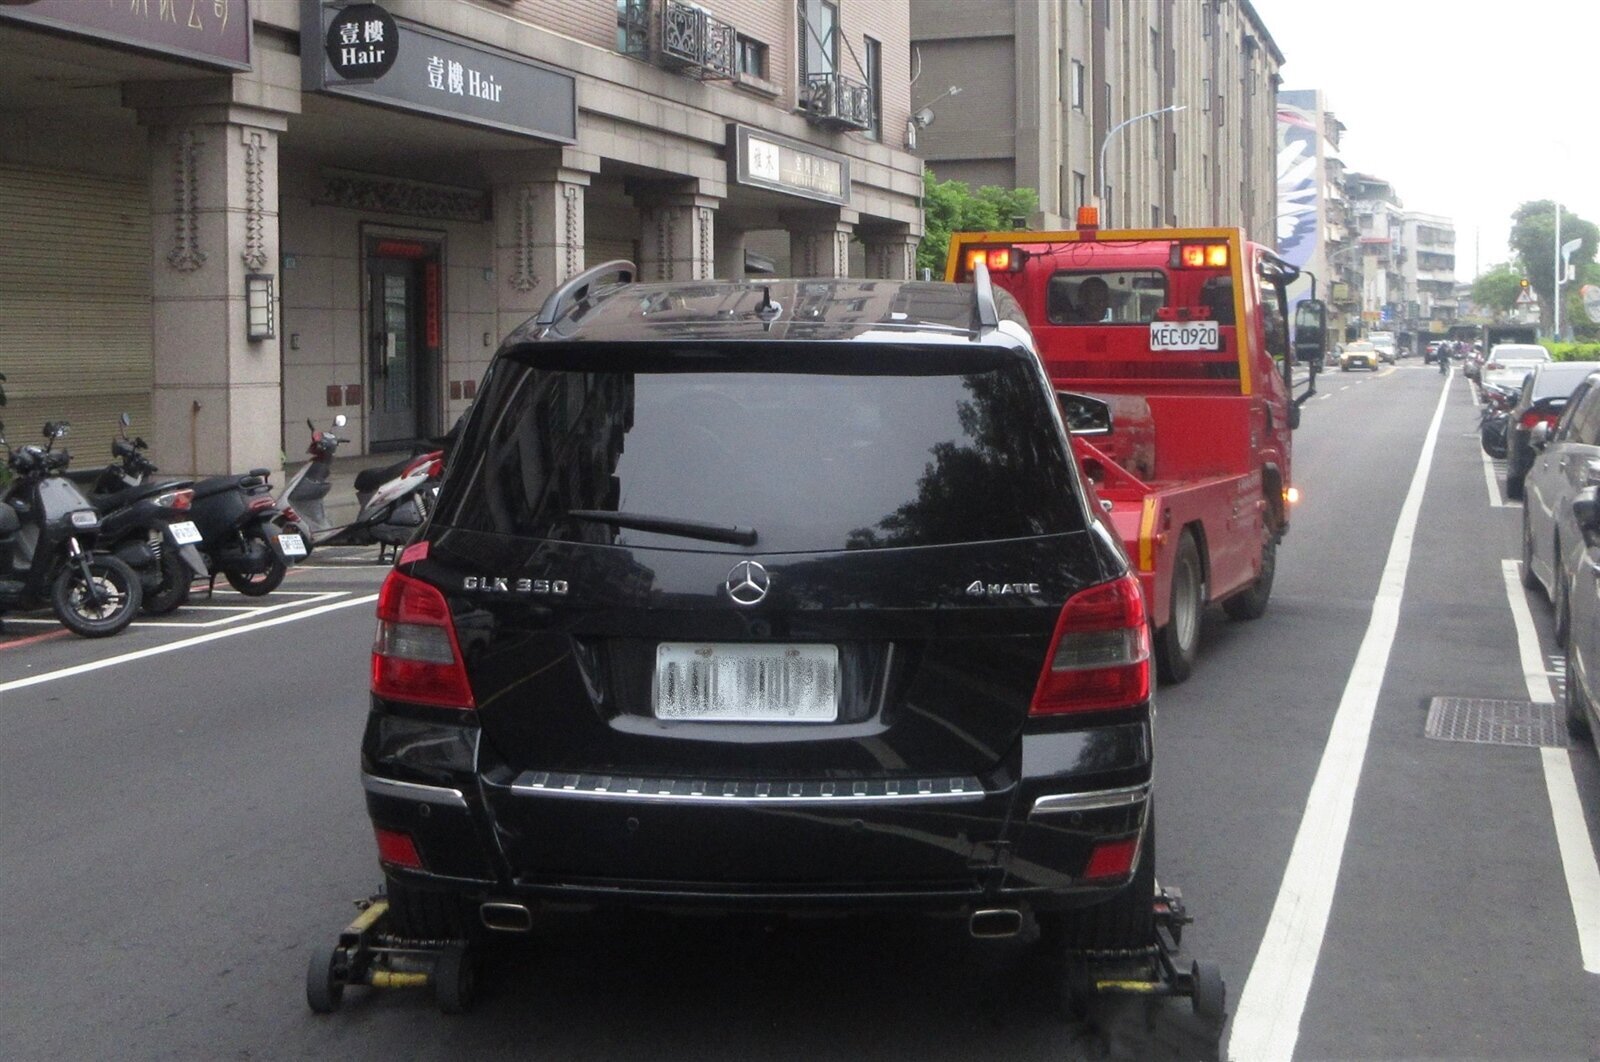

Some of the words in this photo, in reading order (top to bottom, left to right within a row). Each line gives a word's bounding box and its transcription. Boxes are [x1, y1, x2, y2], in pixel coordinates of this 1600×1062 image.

[340, 20, 385, 45] 壹樓
[341, 46, 385, 66] Hair
[427, 56, 464, 96] 壹樓
[468, 69, 502, 102] Hair
[463, 576, 508, 592] GLK
[516, 578, 569, 594] 350
